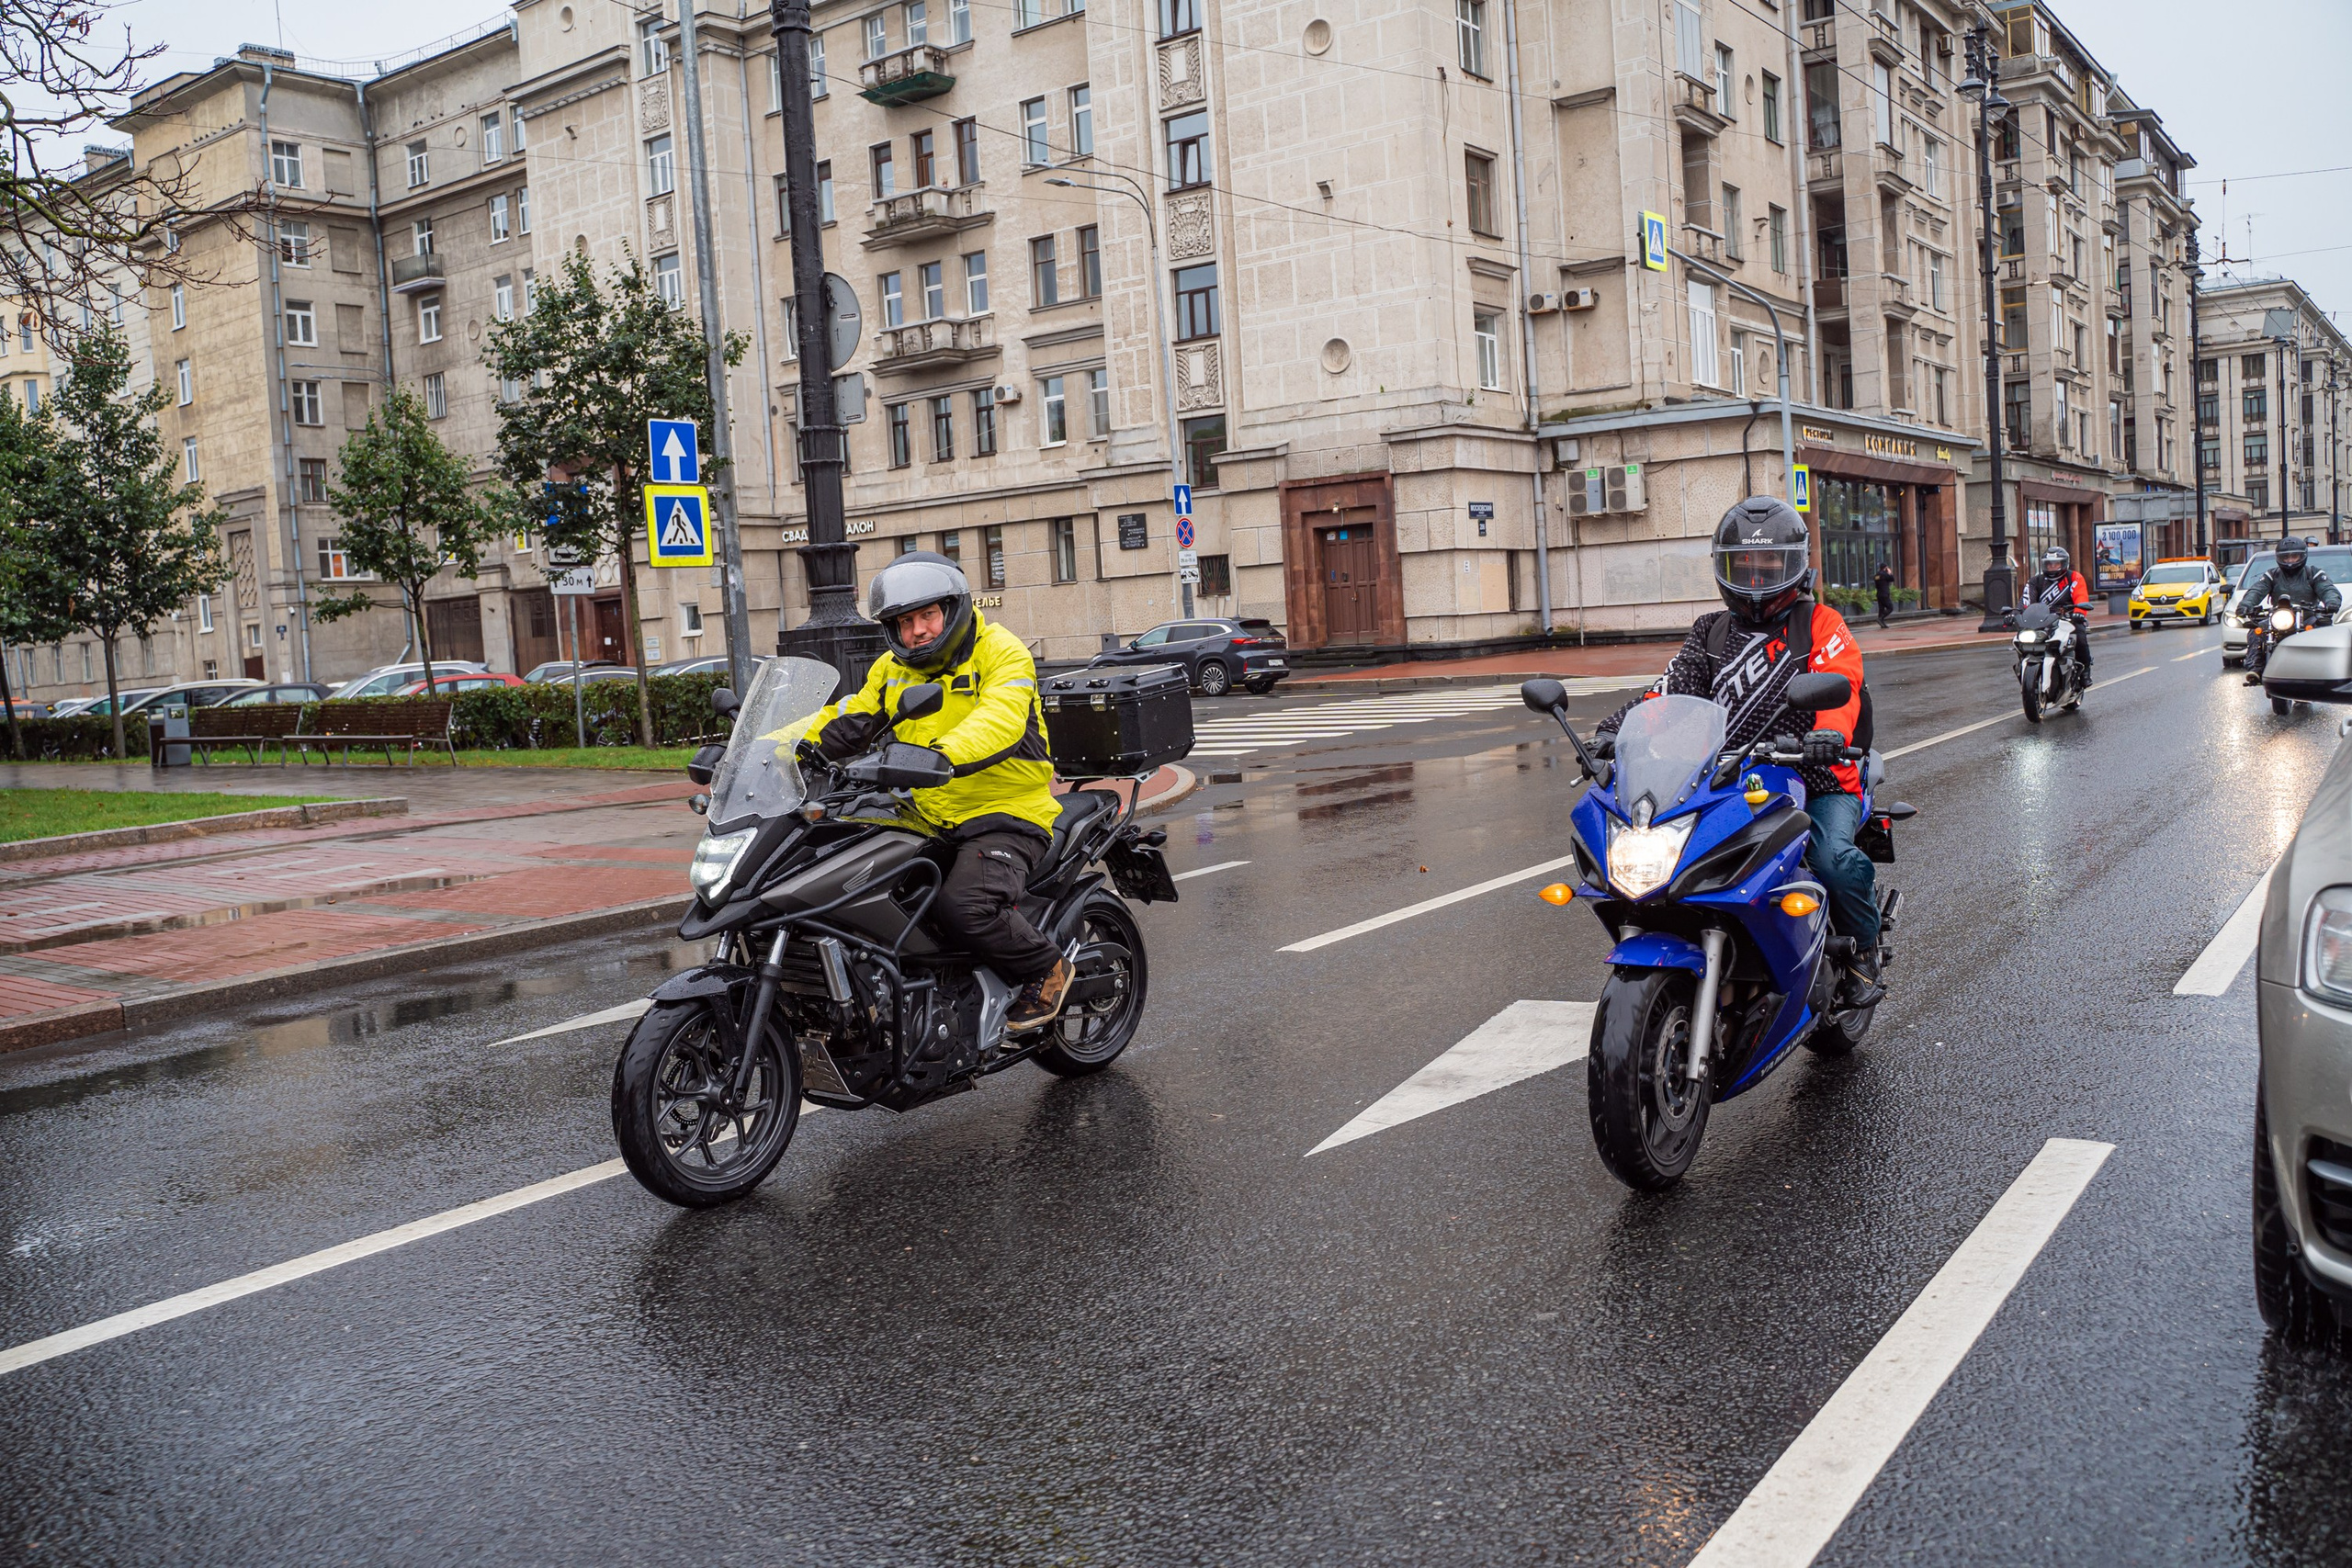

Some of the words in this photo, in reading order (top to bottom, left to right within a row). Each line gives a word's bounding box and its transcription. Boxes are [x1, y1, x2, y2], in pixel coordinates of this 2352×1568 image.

[782, 529, 808, 542] СВАД
[845, 520, 874, 535] АЛОН
[562, 576, 574, 587] 30
[972, 596, 1002, 607] ТЕЛЬЕ
